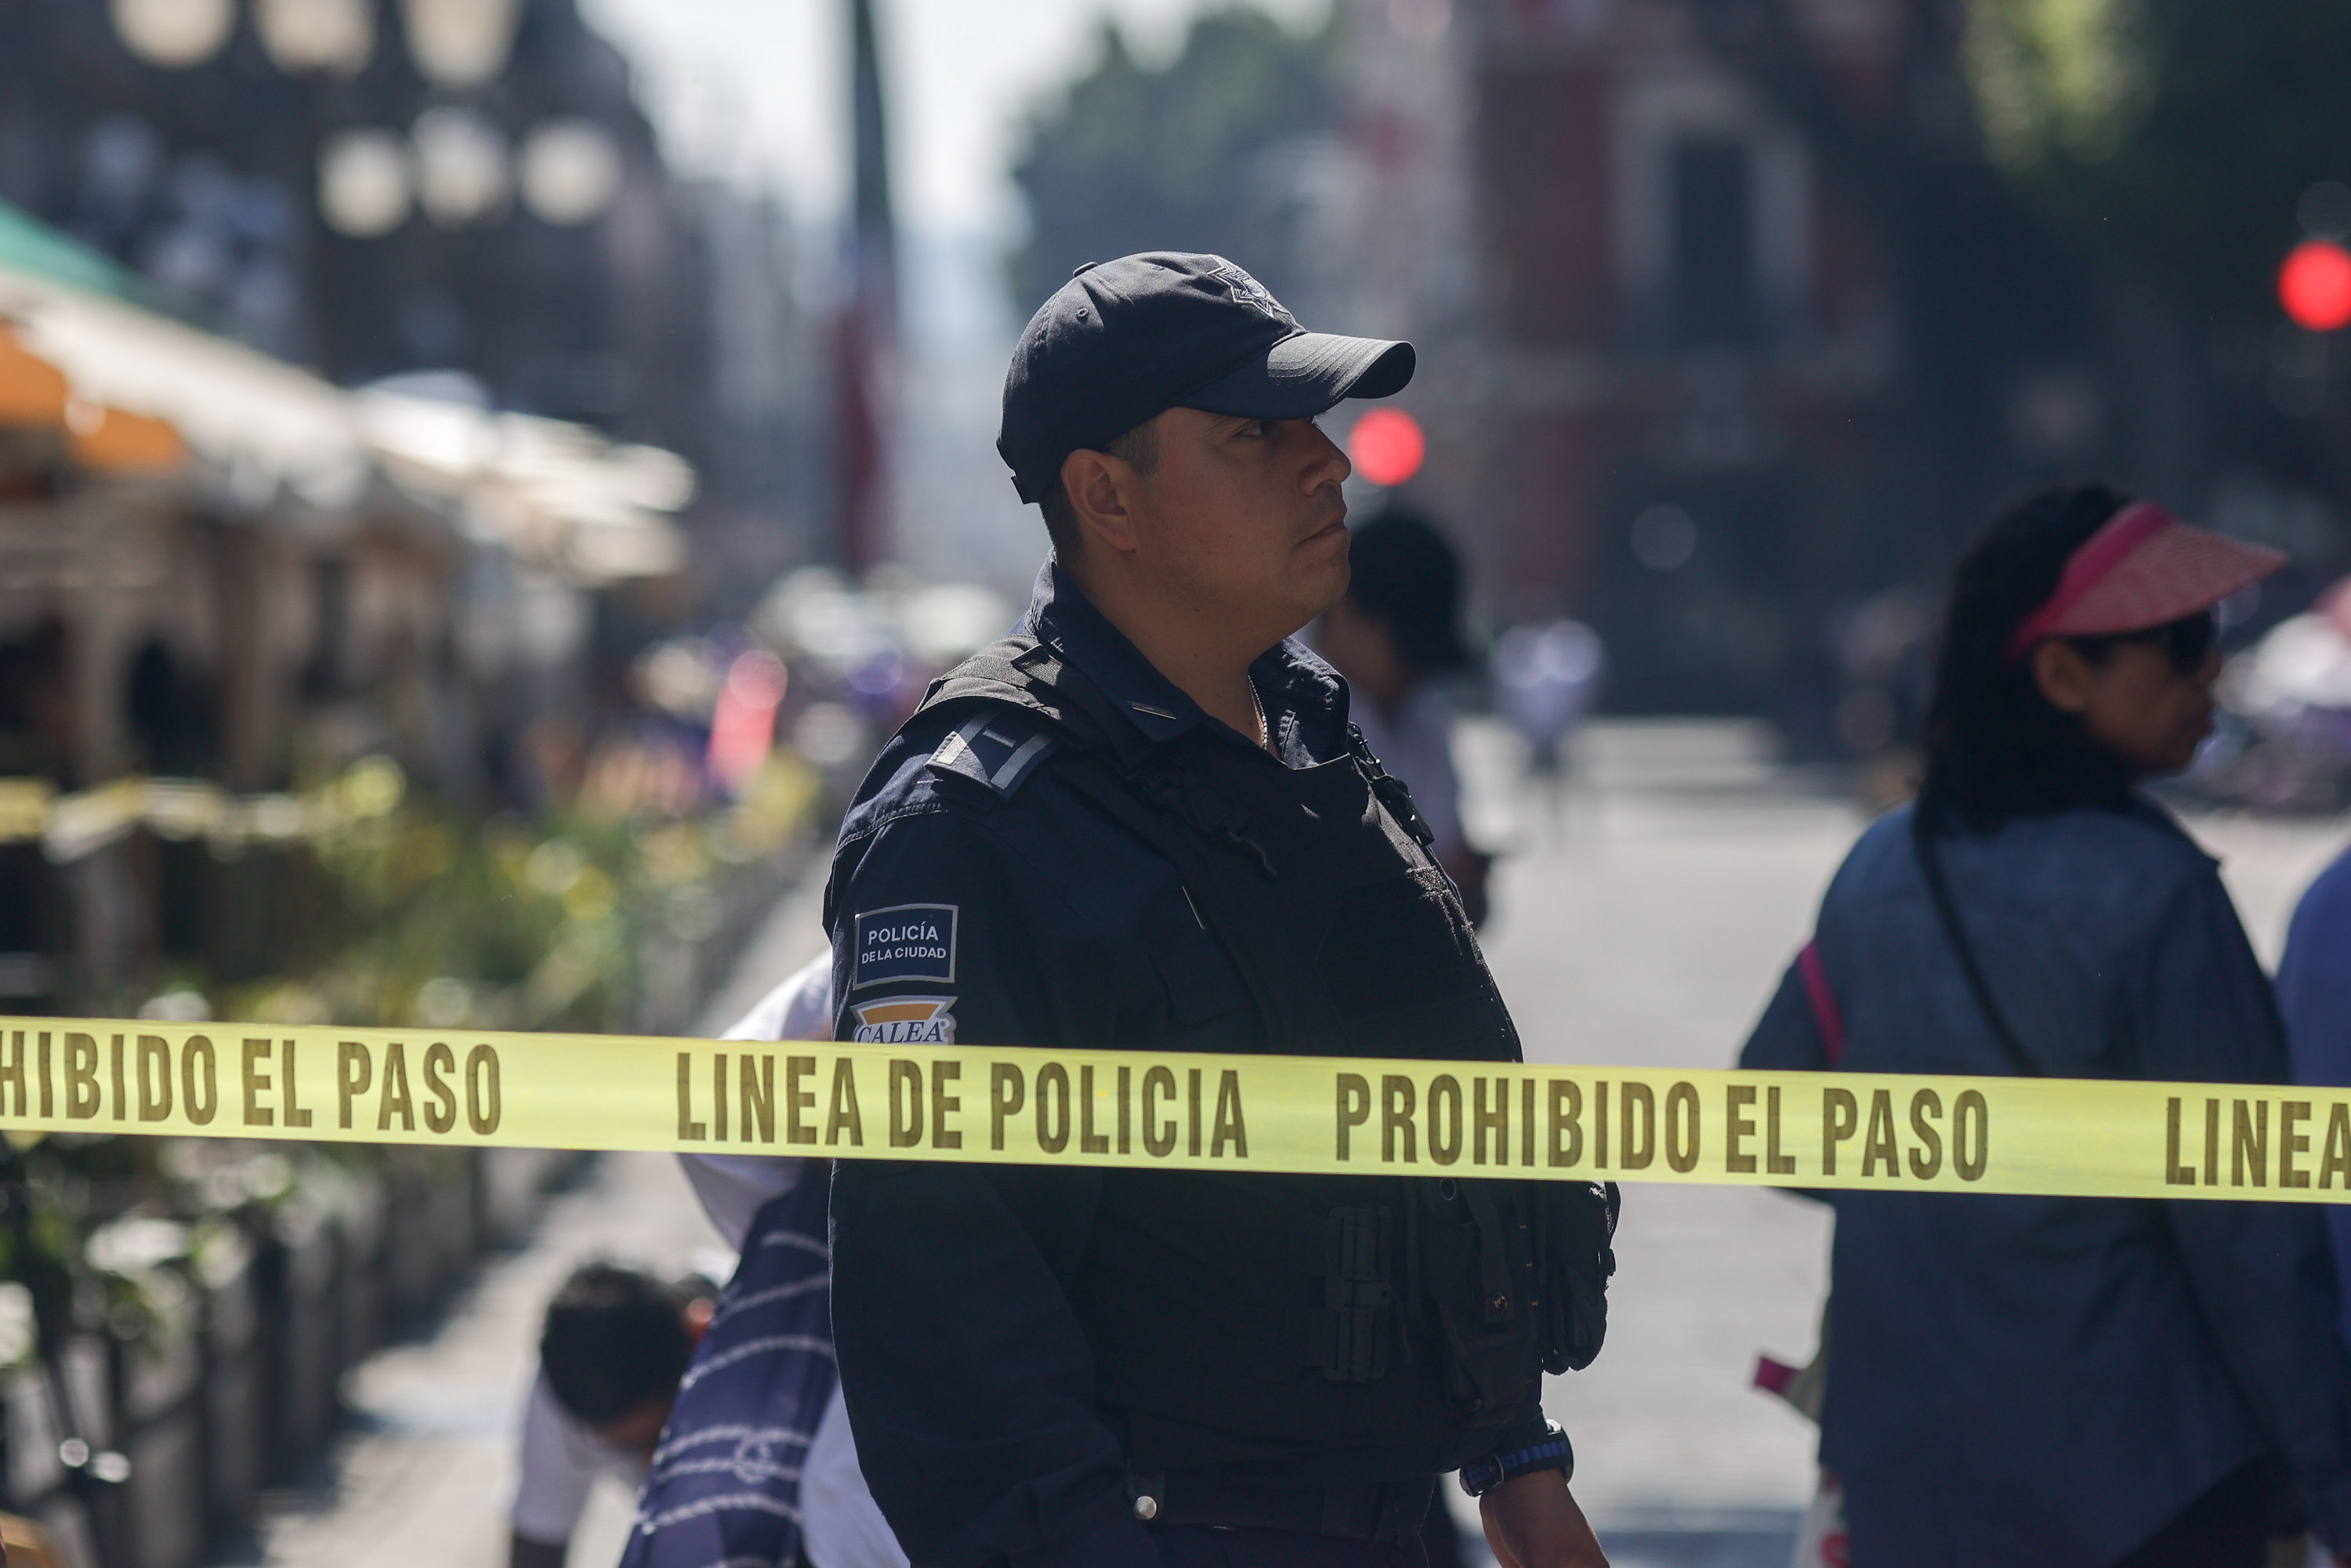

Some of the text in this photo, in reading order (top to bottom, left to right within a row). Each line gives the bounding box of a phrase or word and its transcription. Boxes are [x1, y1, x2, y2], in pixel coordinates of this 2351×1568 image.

[868, 922, 939, 945] POLICÍA
[862, 947, 947, 964] DE LA CIUDAD
[242, 1038, 312, 1128] EL
[337, 1041, 501, 1135] PASO
[676, 1052, 864, 1146] LINEA
[889, 1059, 962, 1150] DE
[991, 1061, 1248, 1159] POLICIA
[1335, 1073, 1701, 1174] PROHIBIDO
[1726, 1085, 1795, 1175] EL
[1822, 1088, 1989, 1182] PASO
[2165, 1097, 2351, 1190] LINEA
